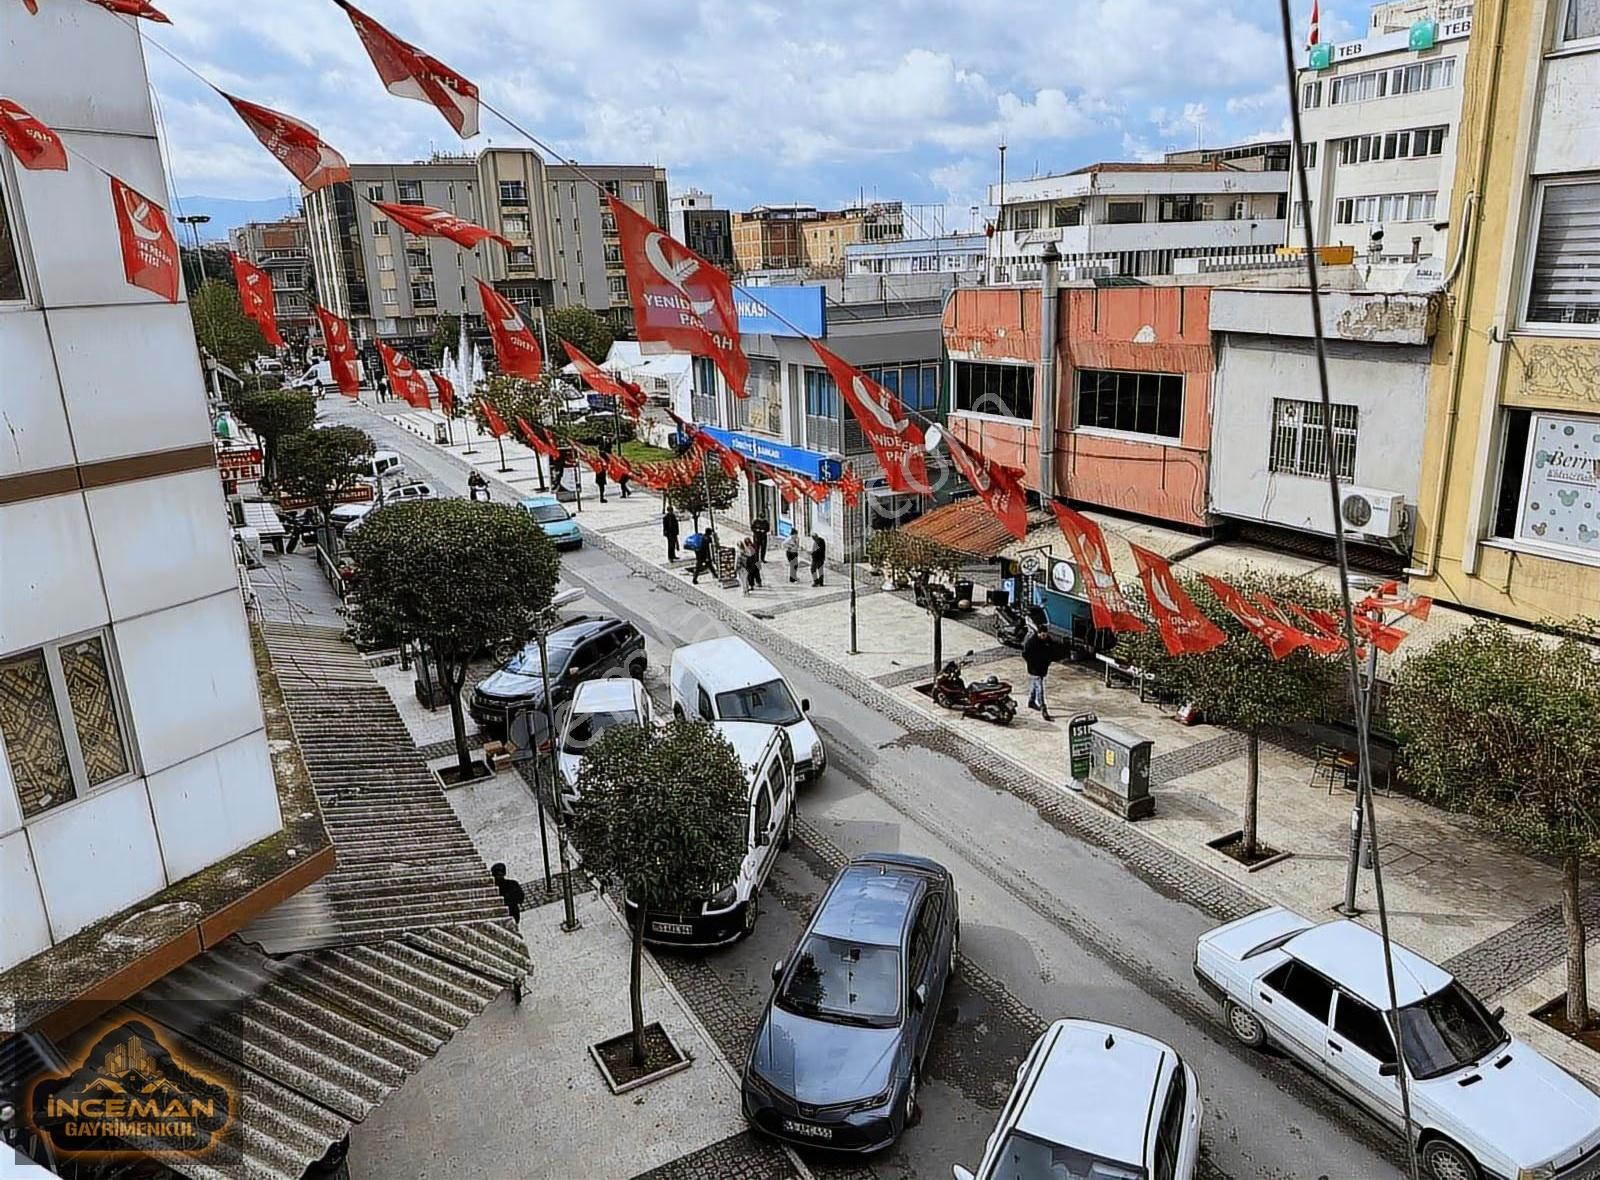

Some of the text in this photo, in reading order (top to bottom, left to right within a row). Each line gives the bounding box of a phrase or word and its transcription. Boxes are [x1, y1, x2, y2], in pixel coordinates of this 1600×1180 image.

[1444, 20, 1471, 36] TEB
[1338, 43, 1362, 57] TEB
[643, 293, 690, 311] YENİD
[220, 465, 260, 480] OTEL
